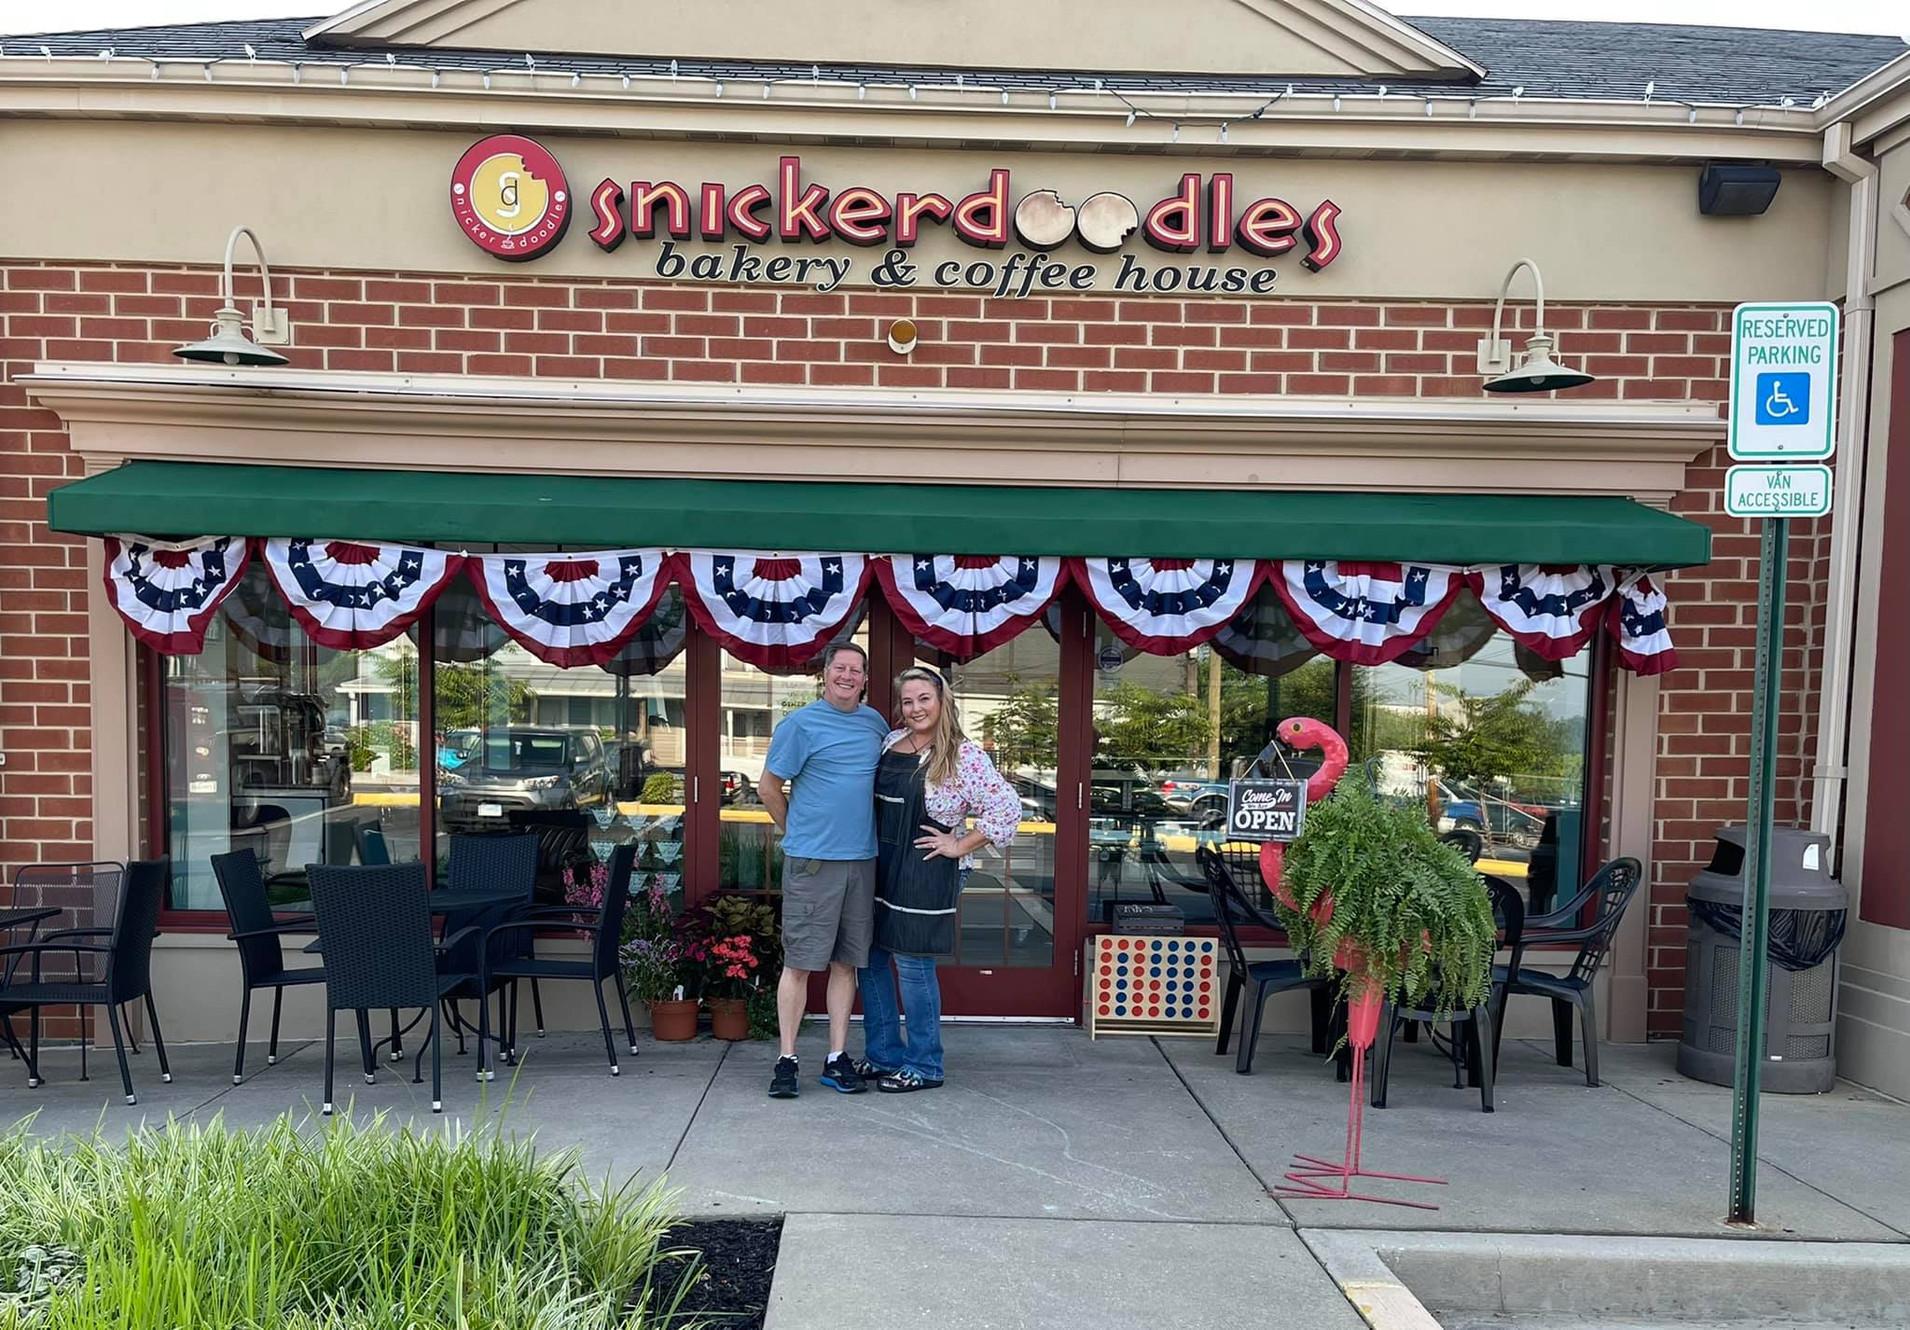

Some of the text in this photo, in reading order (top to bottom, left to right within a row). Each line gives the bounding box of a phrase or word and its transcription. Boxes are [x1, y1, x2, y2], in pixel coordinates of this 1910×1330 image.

[588, 155, 1343, 273] snickerdoodles
[655, 241, 1278, 298] bakery & coffee house
[1742, 318, 1829, 338] RESERVED
[1748, 345, 1821, 365] PARKING
[1766, 474, 1791, 489] VAN
[1738, 492, 1819, 507] ACCESSIBLE
[1241, 788, 1293, 803] Come In
[1235, 810, 1296, 832] OPEN
